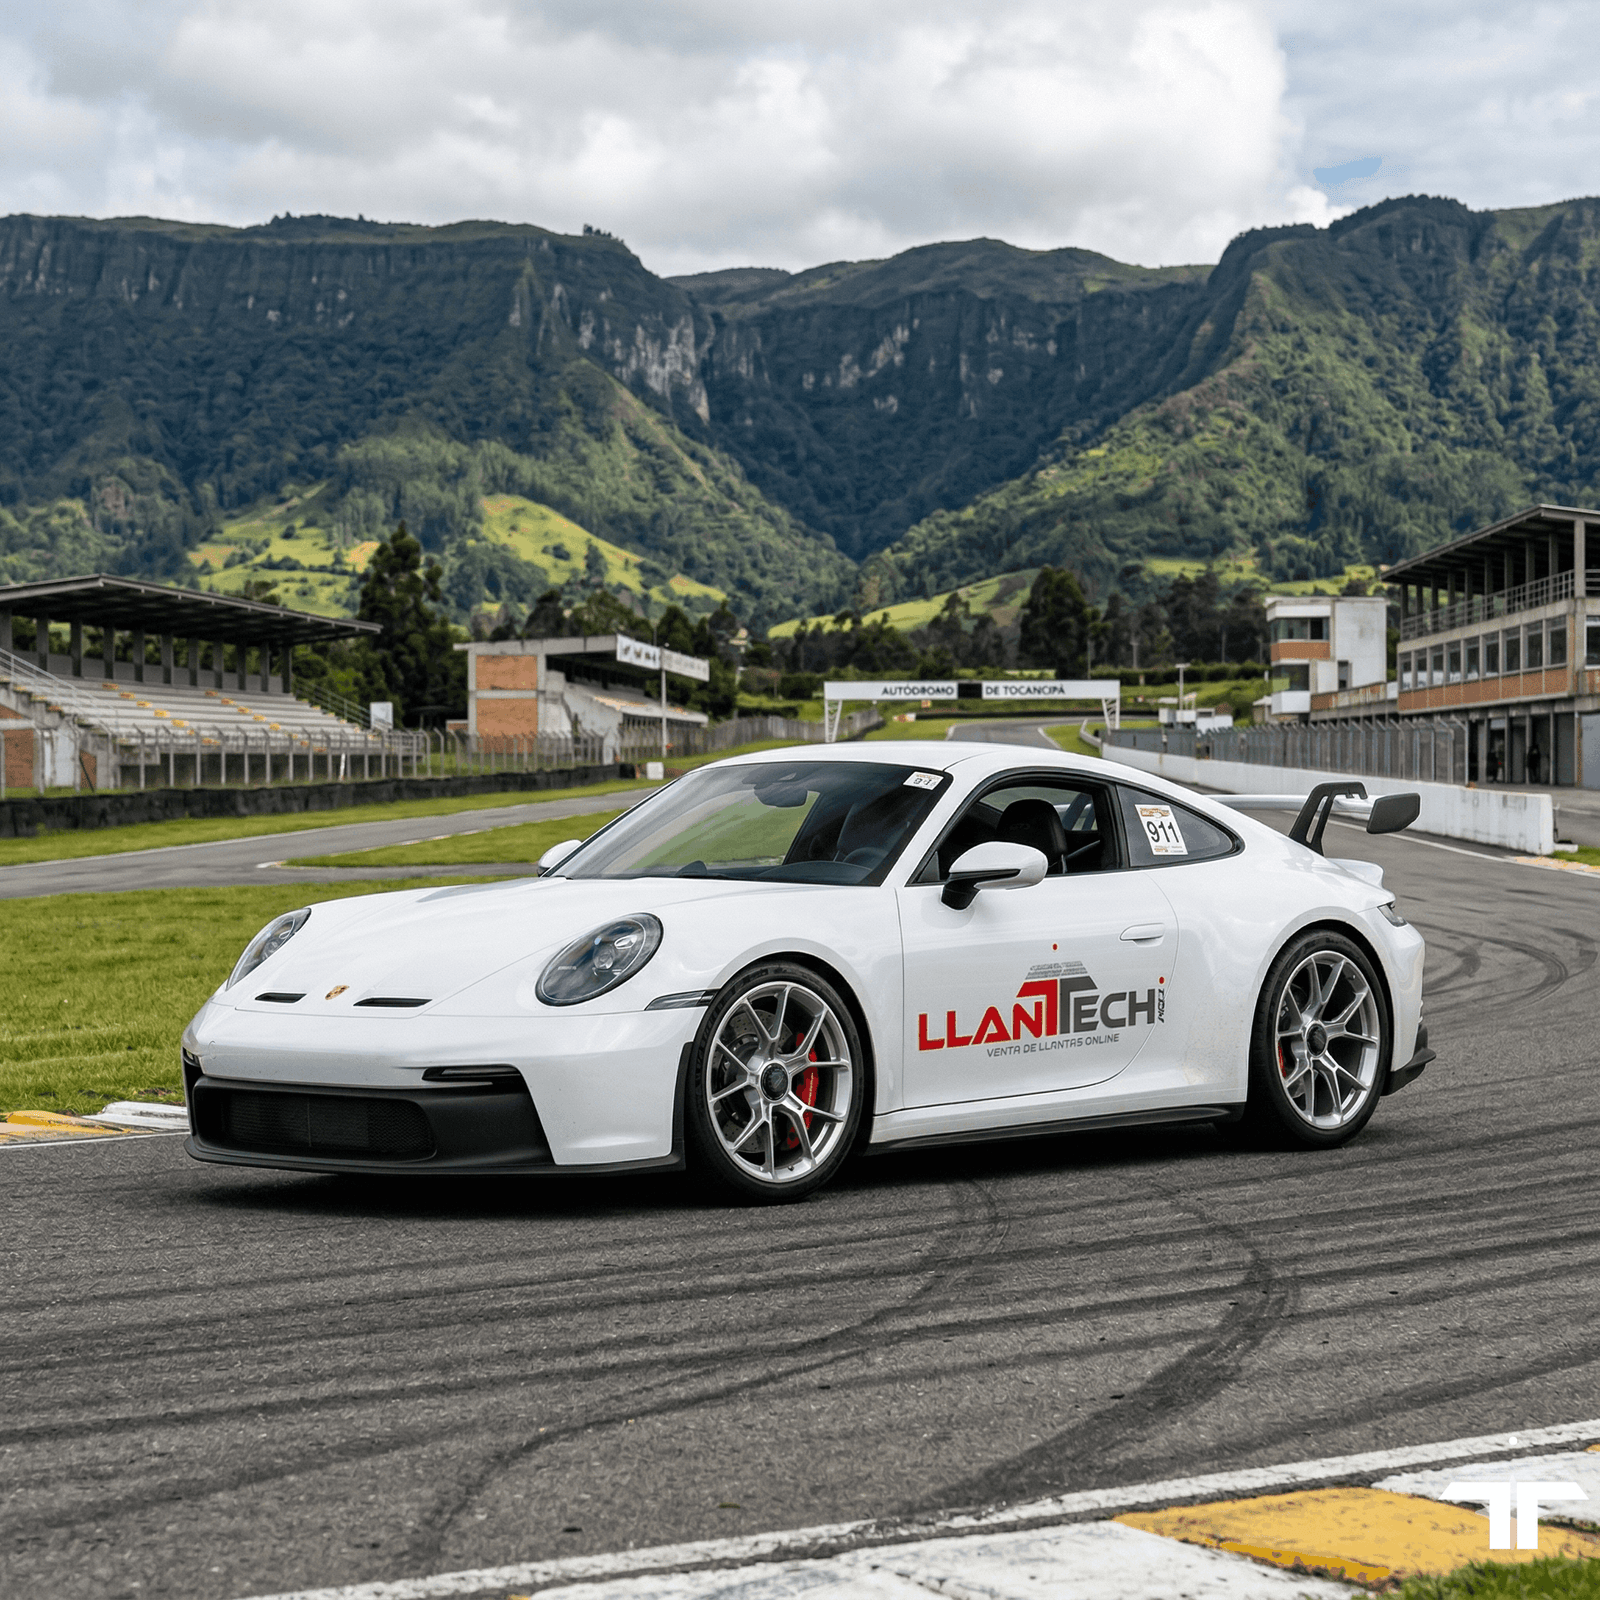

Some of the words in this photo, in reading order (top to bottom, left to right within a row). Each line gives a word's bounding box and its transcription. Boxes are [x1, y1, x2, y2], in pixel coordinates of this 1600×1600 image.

[985, 685, 1000, 696] DE
[1146, 820, 1180, 843] 911
[986, 1045, 1021, 1058] VENTA
[1023, 1043, 1037, 1054] DE
[1039, 1037, 1084, 1052] LLANTAS
[1085, 1033, 1120, 1046] ONLINE
